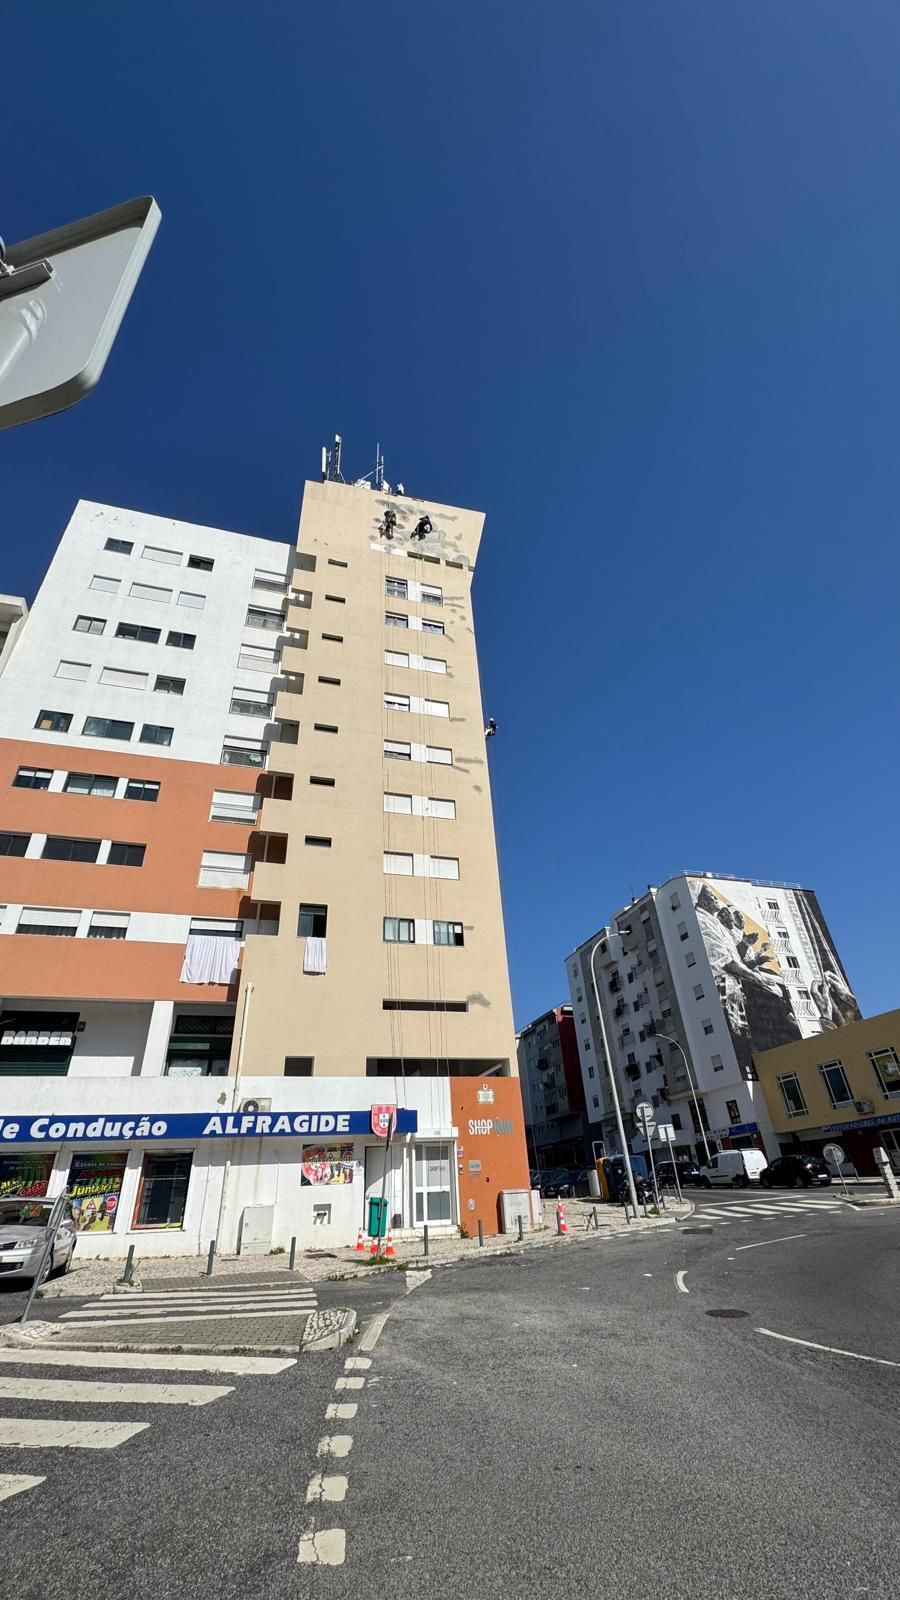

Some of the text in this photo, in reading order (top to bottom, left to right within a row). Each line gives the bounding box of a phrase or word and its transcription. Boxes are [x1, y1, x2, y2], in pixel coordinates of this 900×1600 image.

[0, 1114, 351, 1139] e Condução ALFRAGIDE
[468, 1119, 493, 1135] SHOP
